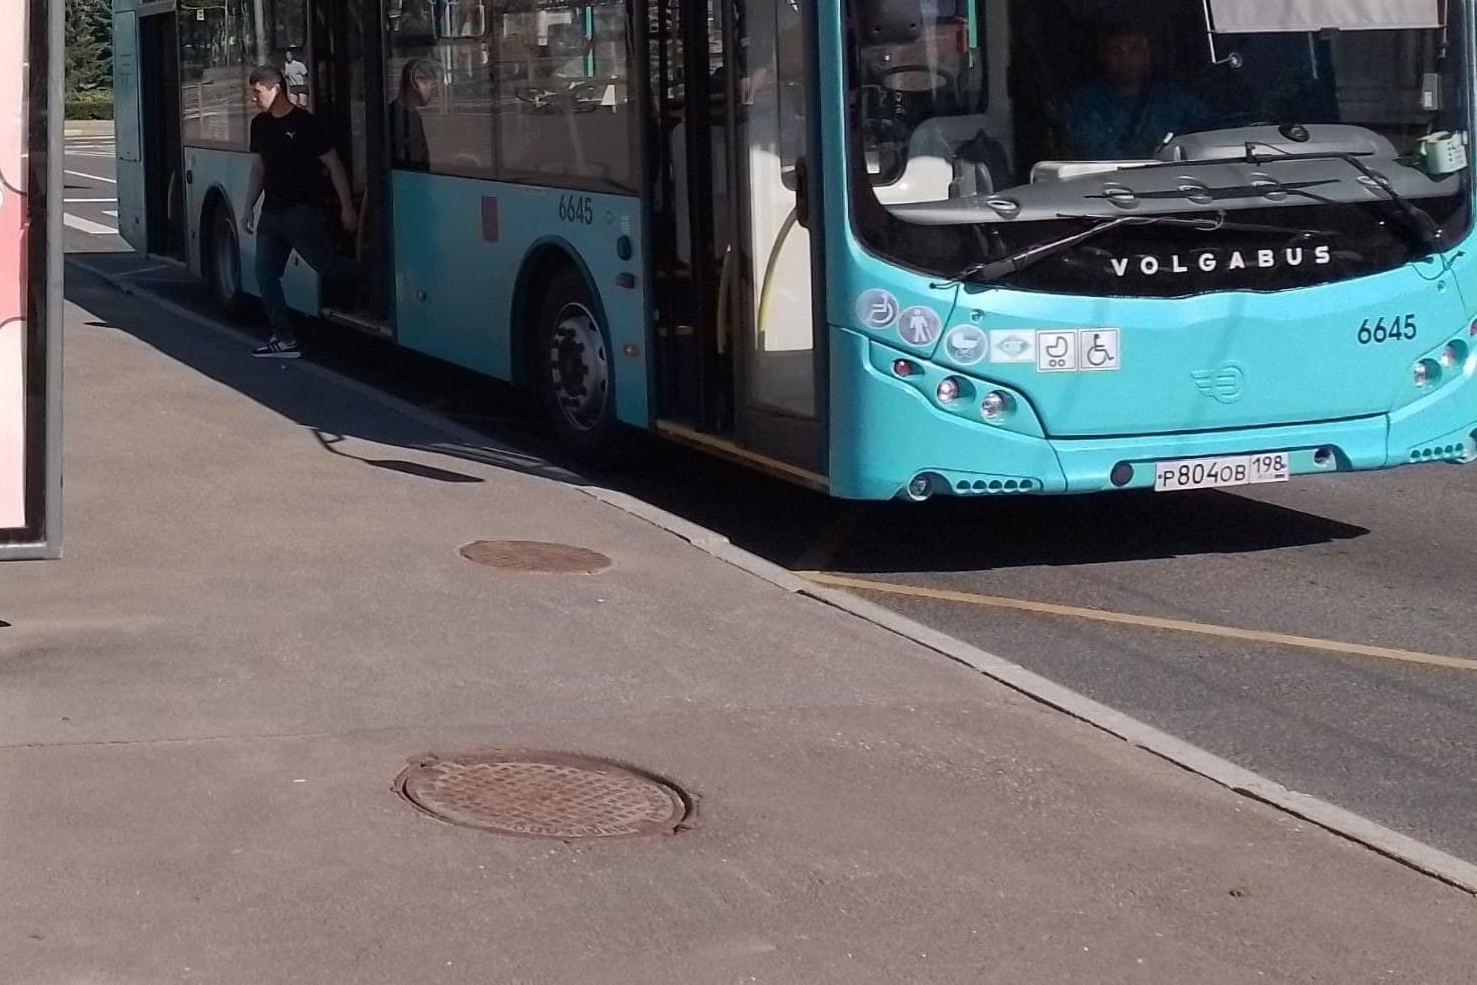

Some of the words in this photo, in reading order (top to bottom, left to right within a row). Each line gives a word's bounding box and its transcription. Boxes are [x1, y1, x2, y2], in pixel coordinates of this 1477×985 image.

[559, 195, 593, 225] 6645
[1110, 245, 1331, 277] VOLGABUS
[1357, 313, 1417, 345] 6645
[1252, 455, 1283, 473] 198
